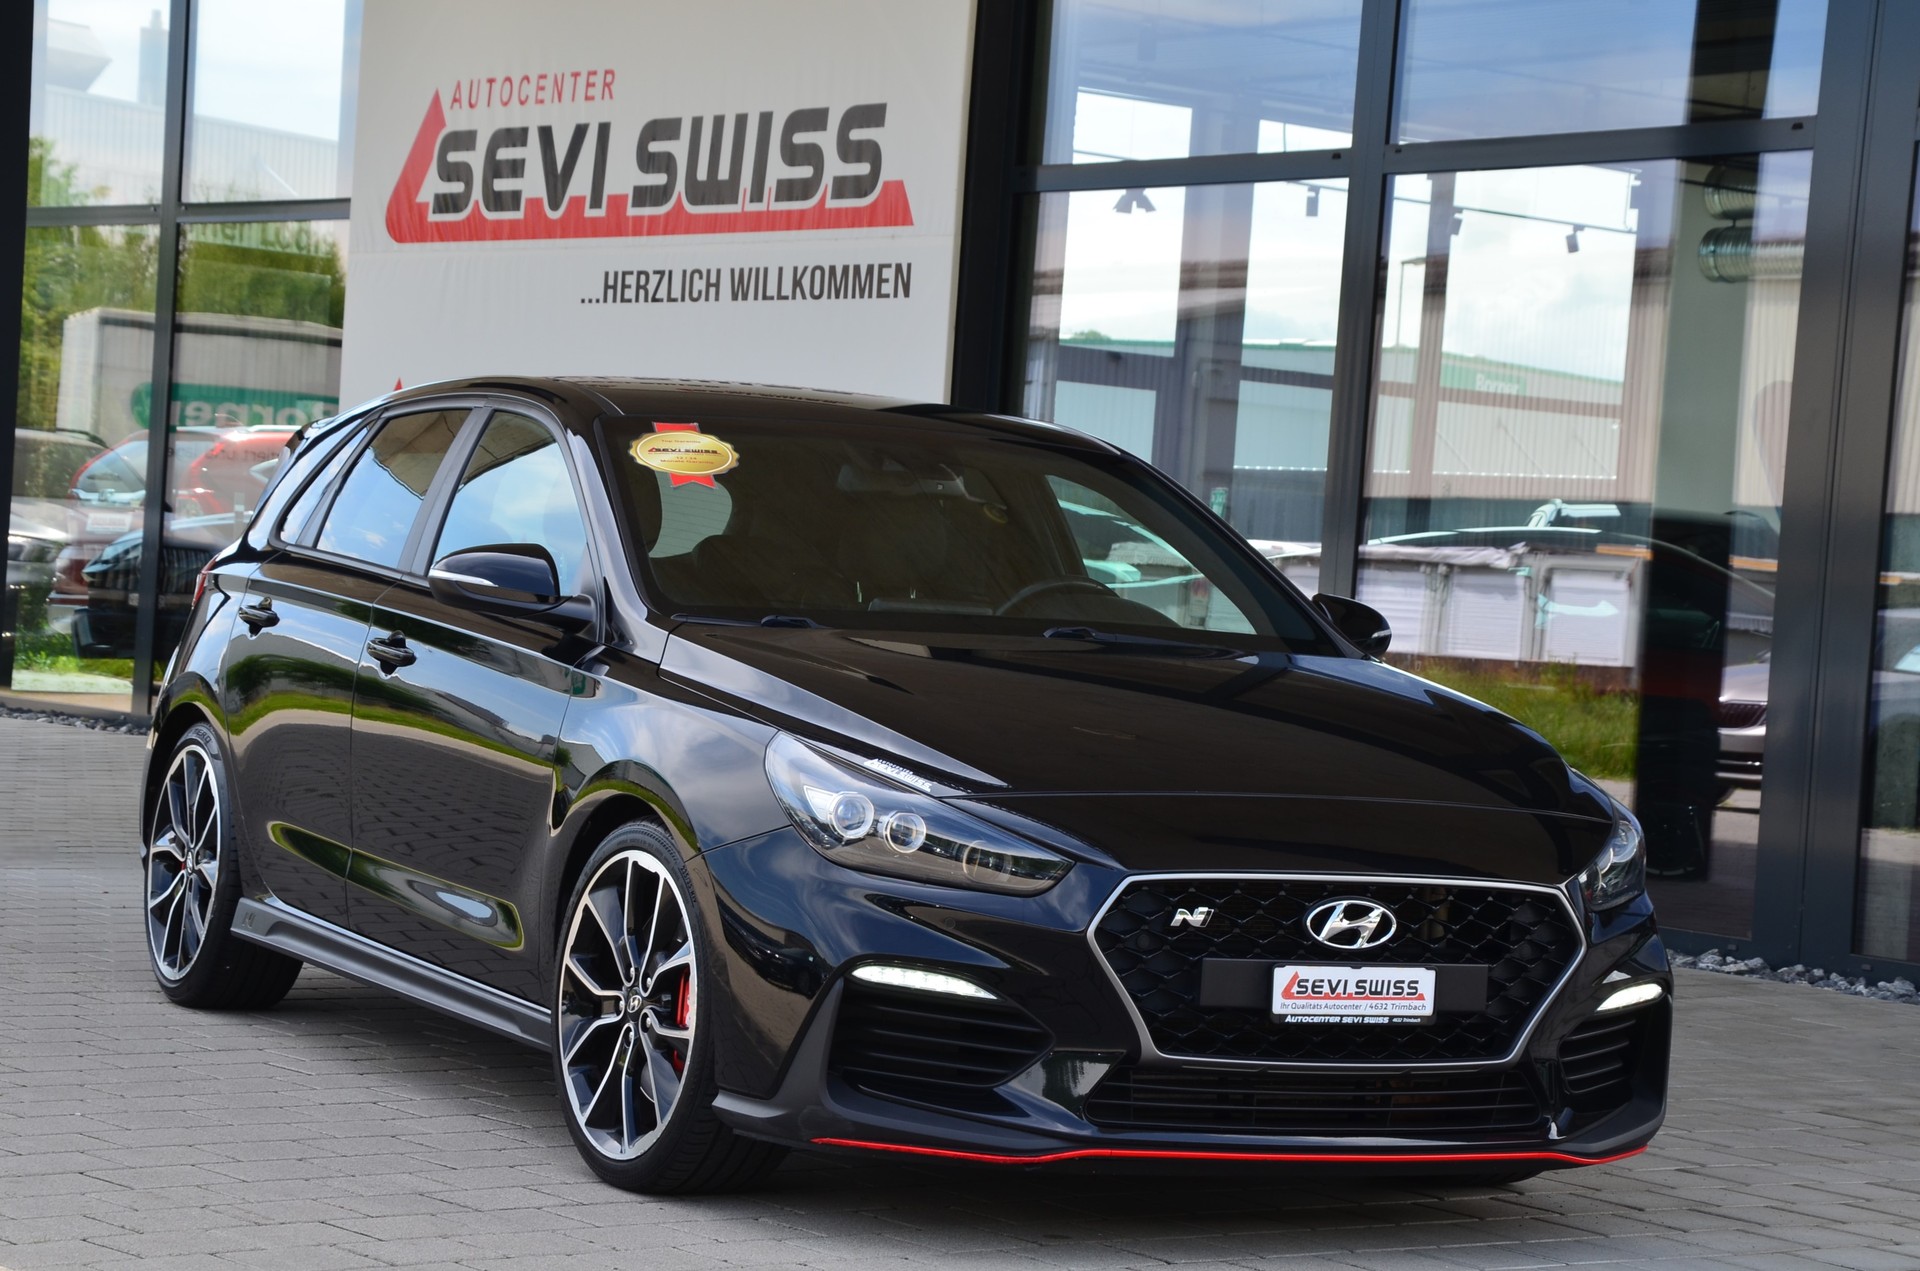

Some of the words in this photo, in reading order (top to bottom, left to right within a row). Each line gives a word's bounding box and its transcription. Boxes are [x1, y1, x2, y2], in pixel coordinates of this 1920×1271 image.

[450, 68, 616, 110] AUTOCENTER
[431, 121, 612, 214] SEVI
[630, 102, 888, 209] SWISS
[580, 267, 721, 305] ...HERZLICH
[730, 262, 912, 302] WILLKOMMEN
[1295, 978, 1349, 996] SEVI
[1354, 979, 1420, 997] SWISS
[1280, 1002, 1290, 1010] Ihr
[1323, 1002, 1363, 1010] Autocenter
[1369, 1002, 1389, 1010] 4632
[1391, 1002, 1427, 1011] Trimbach
[1285, 1014, 1341, 1024] AUTOCENTER
[1342, 1016, 1362, 1024] SEVI
[1363, 1016, 1389, 1024] SWISS
